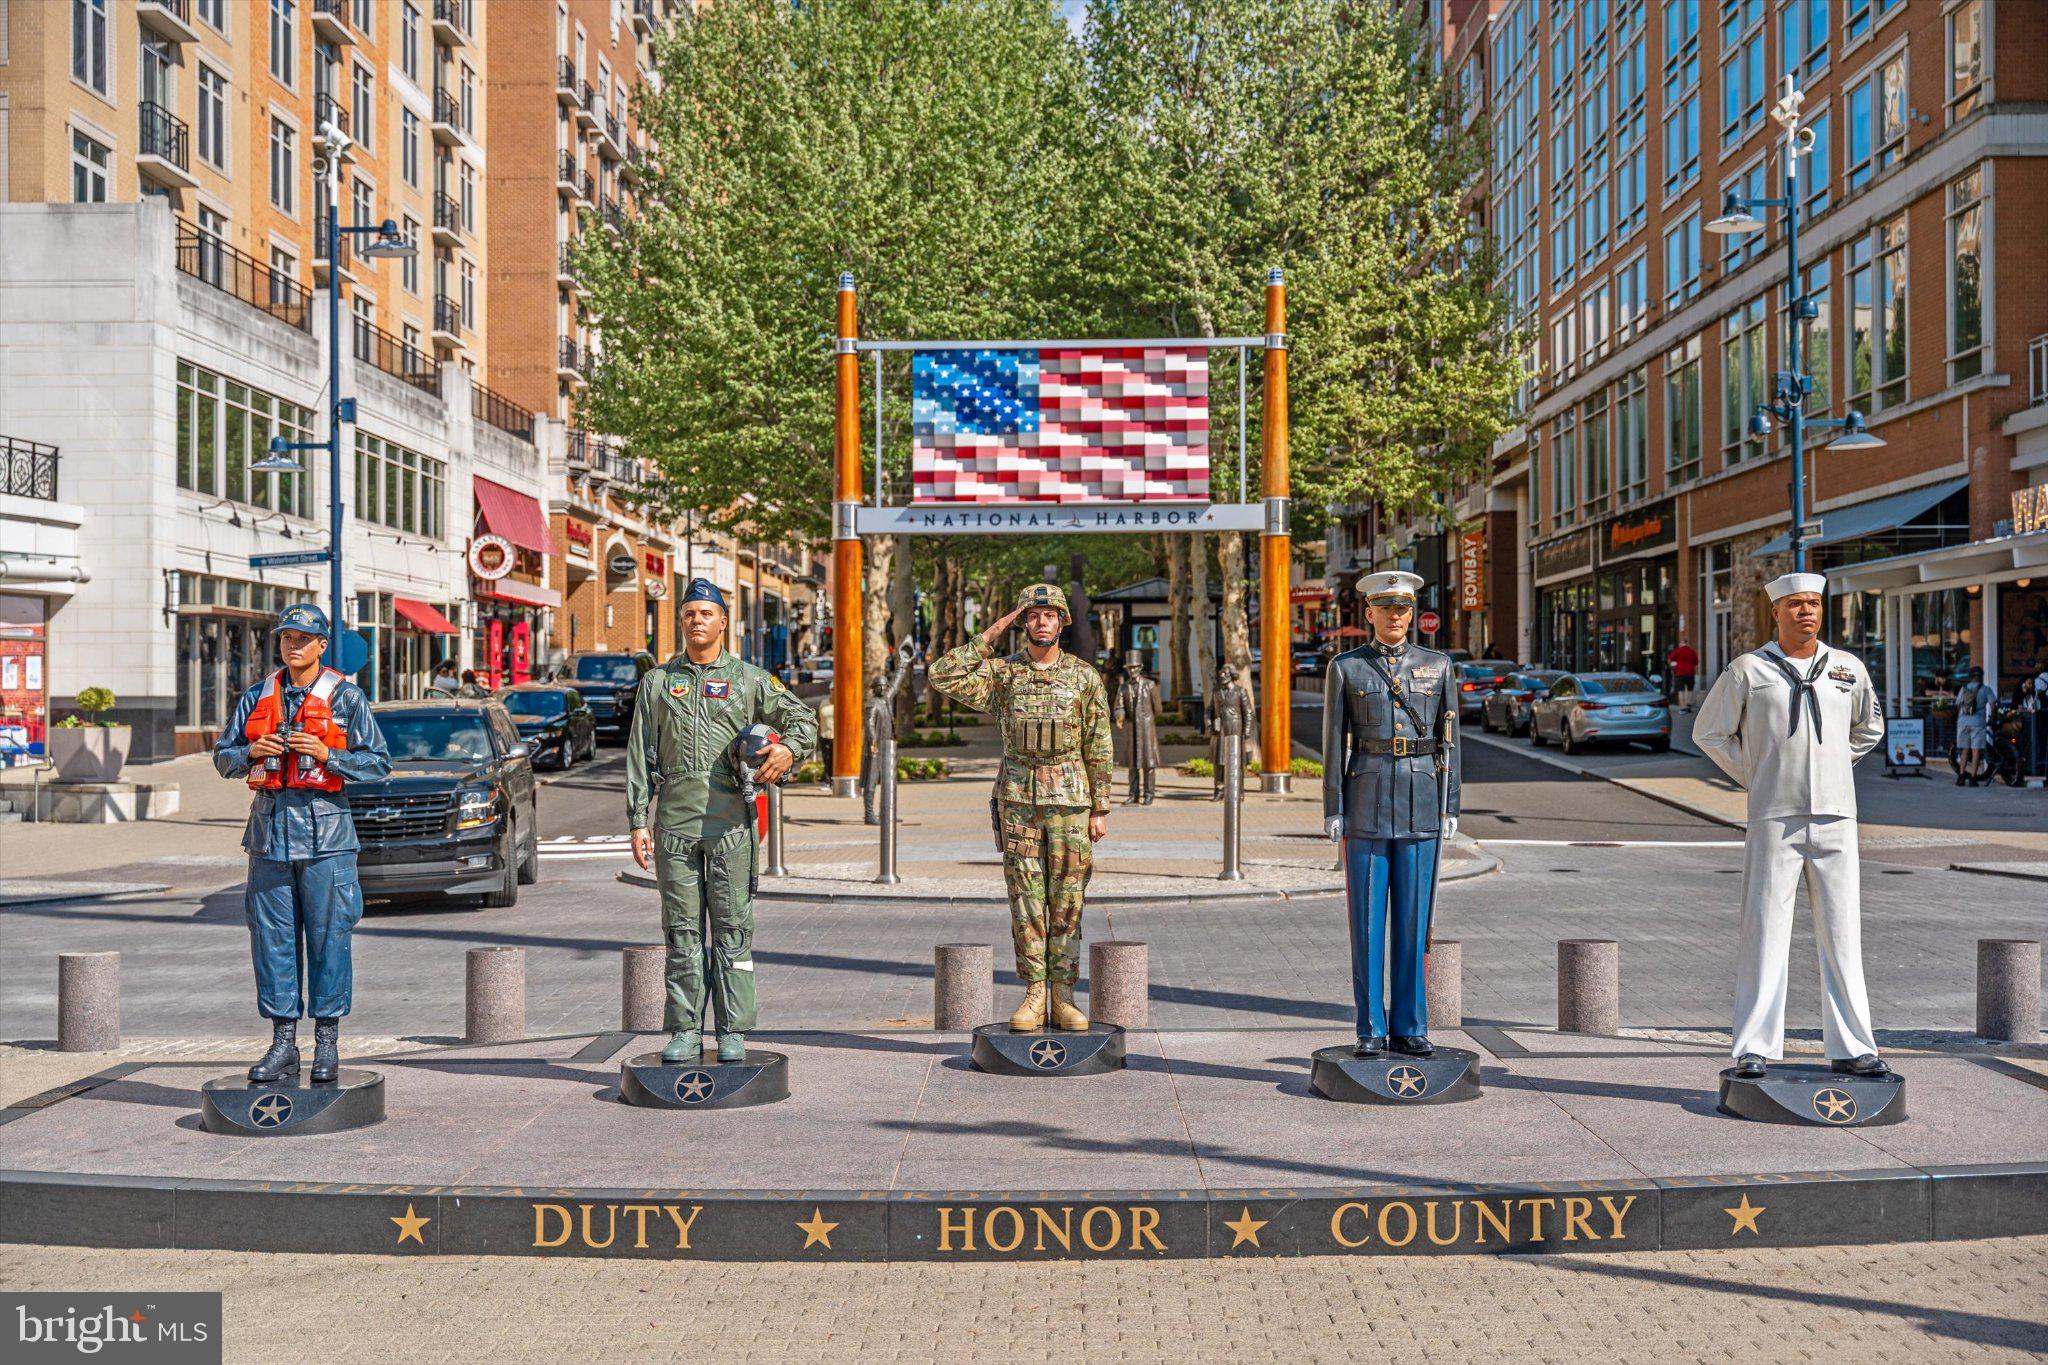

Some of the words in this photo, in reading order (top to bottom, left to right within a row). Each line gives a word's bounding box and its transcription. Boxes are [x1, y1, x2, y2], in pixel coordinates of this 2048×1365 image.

[923, 512, 1055, 526] NATIONAL
[1096, 511, 1198, 525] HARBOR
[268, 555, 300, 565] Waterfront
[300, 554, 318, 562] Street
[1464, 538, 1477, 606] BOMBAY
[1419, 618, 1440, 627] STOP
[236, 1181, 577, 1197] AMERICA'S
[532, 1204, 703, 1249] DUTY
[937, 1206, 1169, 1252] HONOR
[1330, 1196, 1637, 1247] COUNTRY
